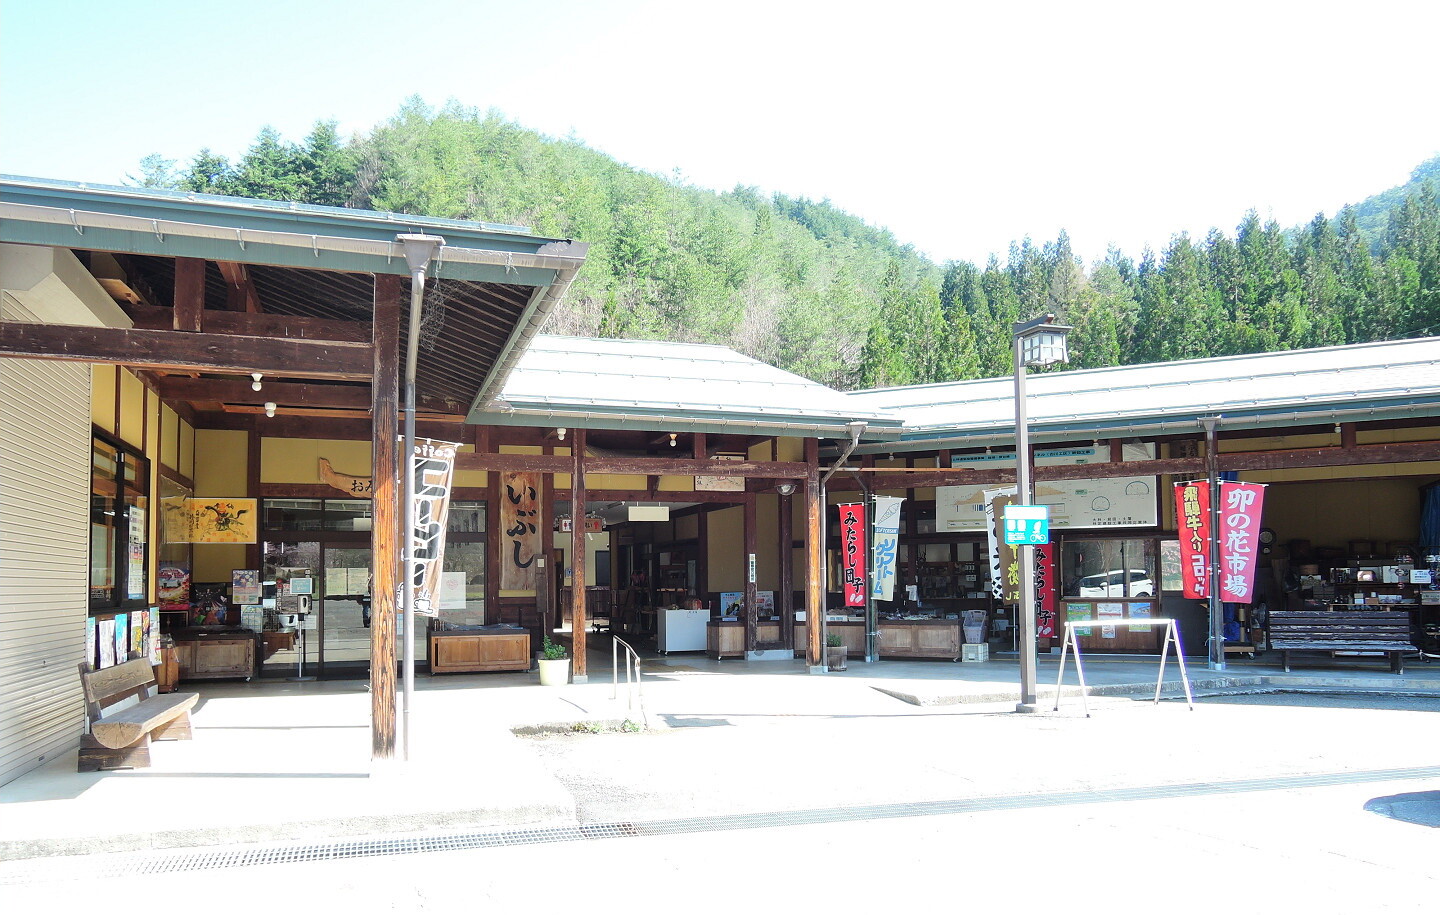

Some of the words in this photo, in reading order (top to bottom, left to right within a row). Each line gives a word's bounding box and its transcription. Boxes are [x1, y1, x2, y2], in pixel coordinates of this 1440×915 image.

[506, 484, 537, 569] いぶし
[844, 511, 864, 594] みたらし団子
[883, 538, 896, 579] ソフト
[1183, 486, 1205, 597] 飛騨牛入りコロッケ
[1224, 488, 1256, 598] 卯の花市場
